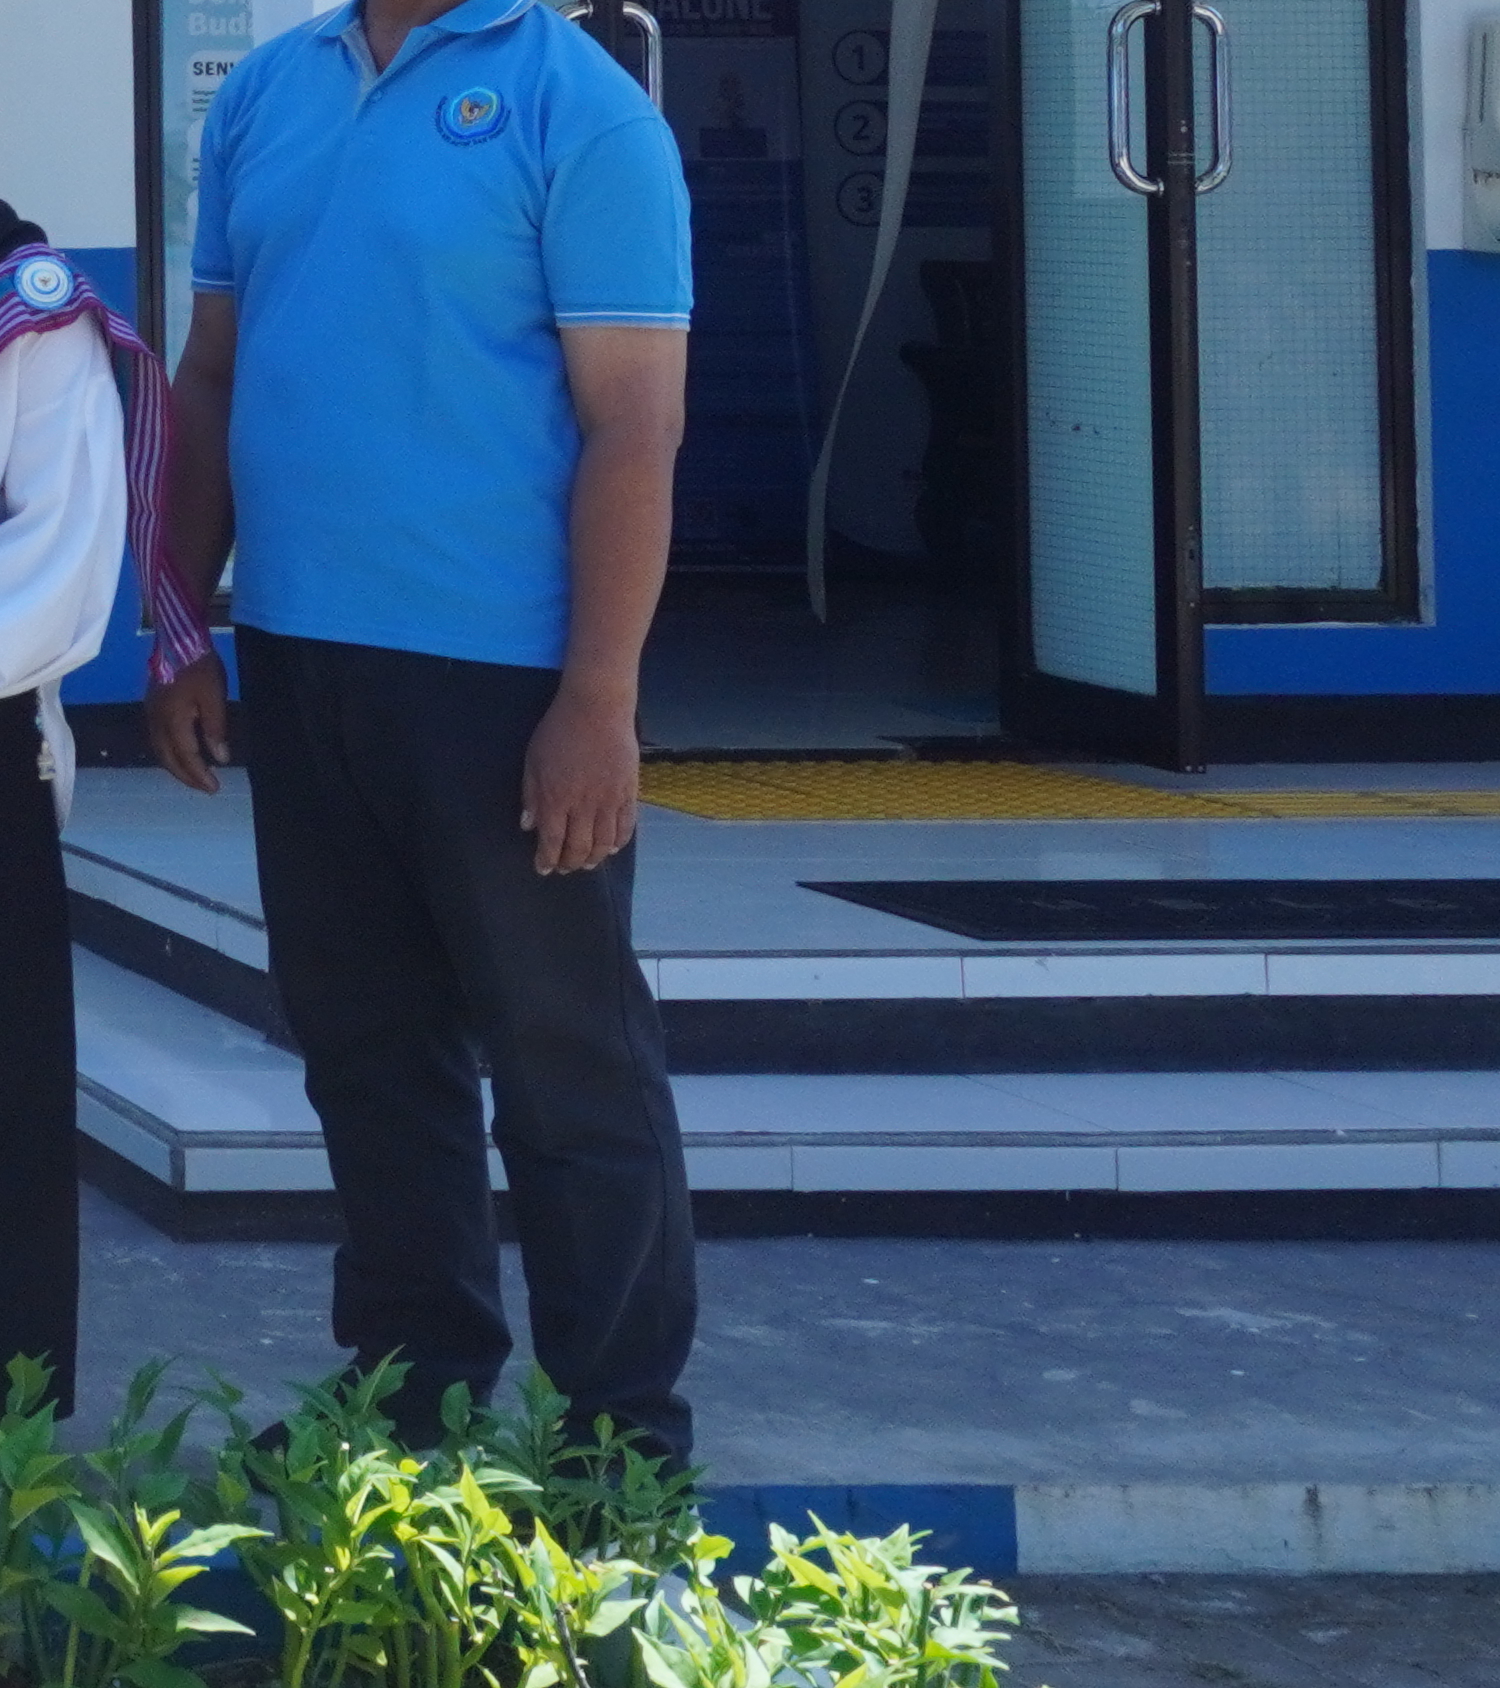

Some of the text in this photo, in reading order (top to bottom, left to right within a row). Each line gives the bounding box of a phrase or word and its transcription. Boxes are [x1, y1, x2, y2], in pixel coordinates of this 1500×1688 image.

[852, 44, 865, 72] 1
[852, 113, 871, 141] 2
[856, 186, 874, 213] 3
